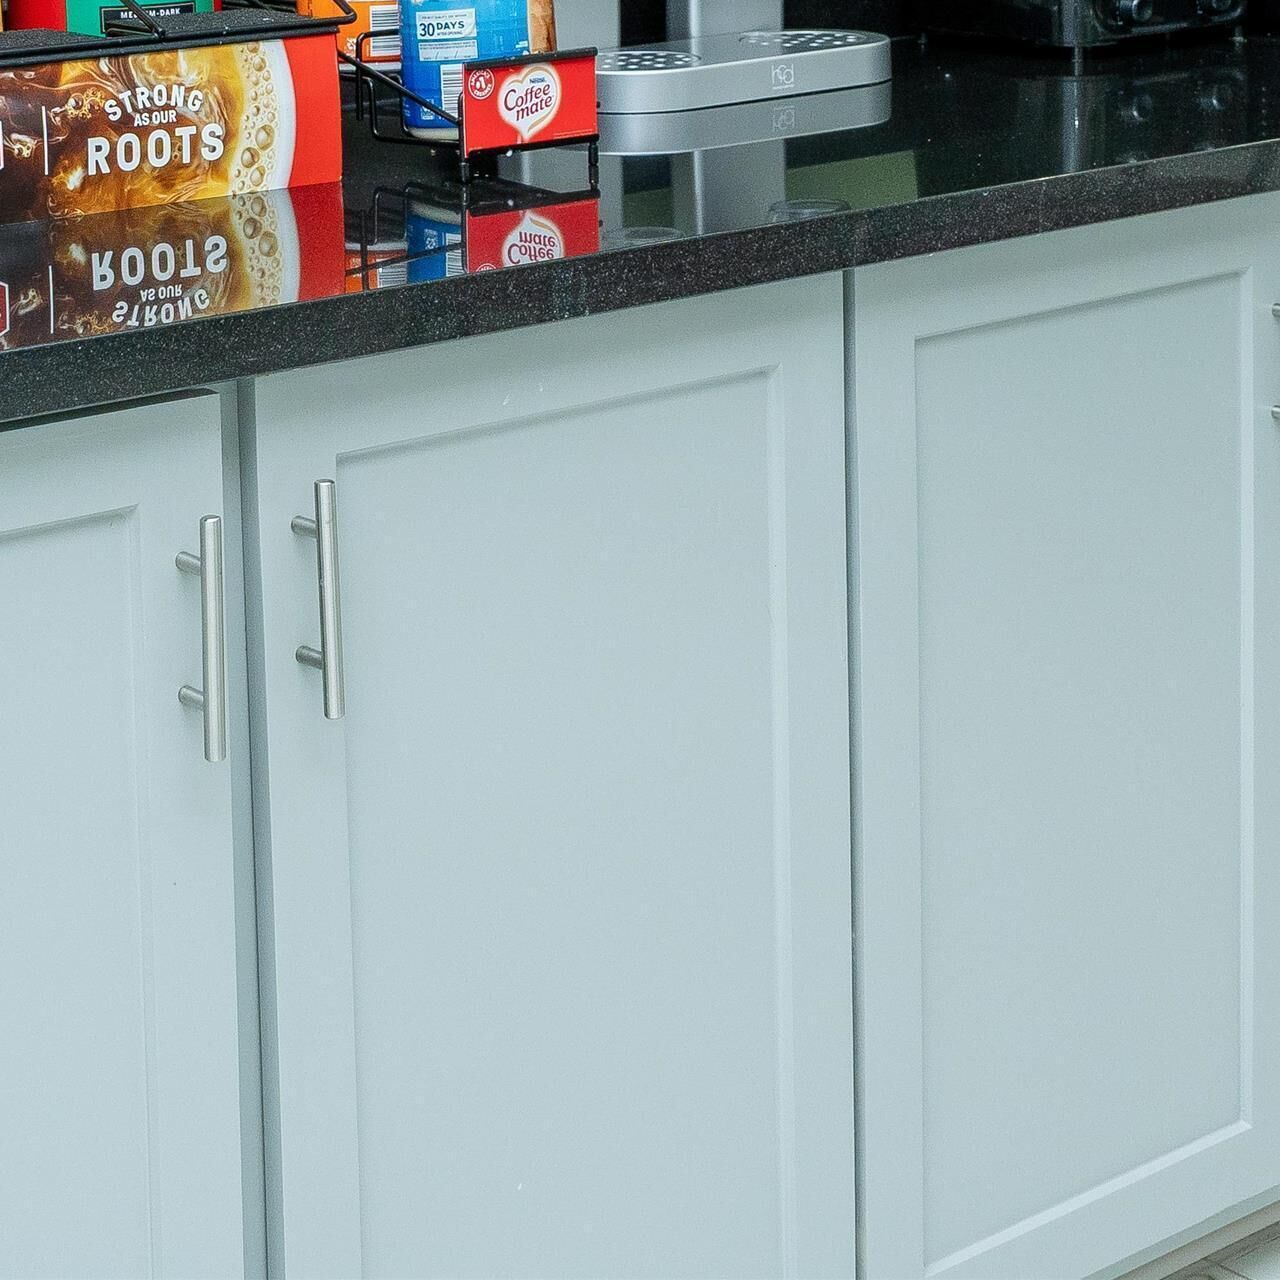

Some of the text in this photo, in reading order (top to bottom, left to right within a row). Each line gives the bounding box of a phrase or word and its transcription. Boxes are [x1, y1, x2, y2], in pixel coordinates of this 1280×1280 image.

[419, 20, 465, 37] 30 DAYS
[104, 84, 203, 121] STRONG
[504, 83, 551, 112] Coffee
[516, 96, 553, 121] mate
[133, 110, 177, 127] AS OUR
[87, 123, 224, 176] ROOTS
